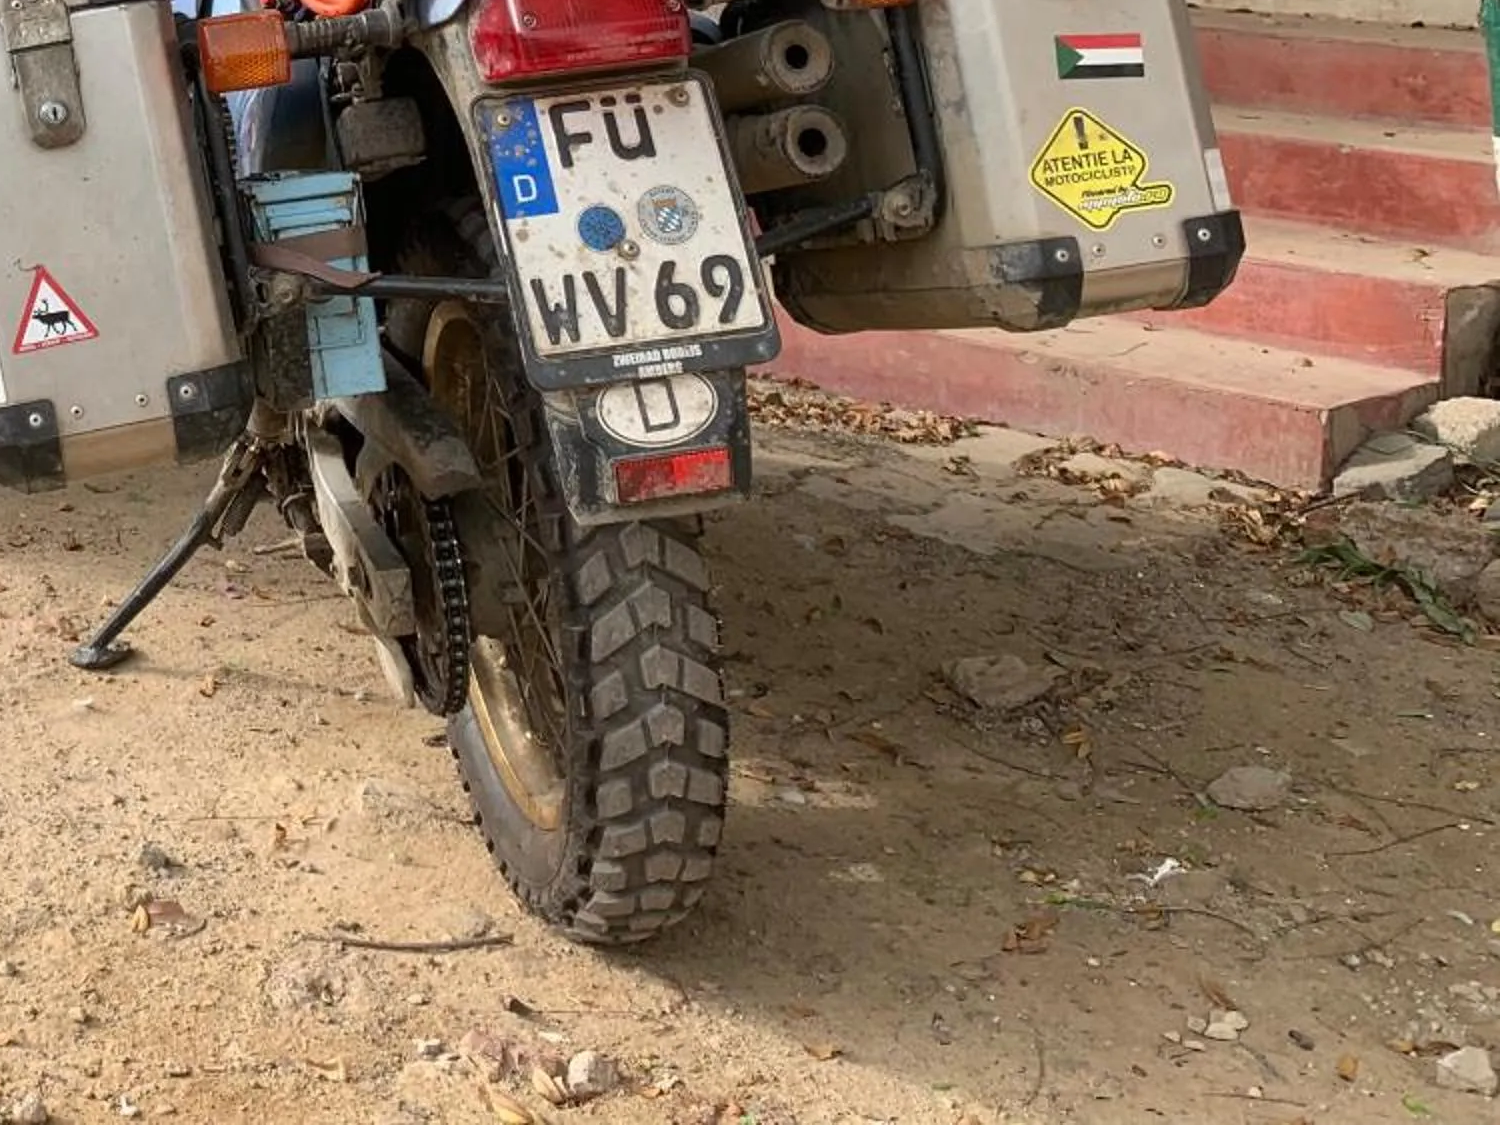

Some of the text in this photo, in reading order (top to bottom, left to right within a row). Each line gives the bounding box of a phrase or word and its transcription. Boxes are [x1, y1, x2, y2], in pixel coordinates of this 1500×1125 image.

[548, 92, 657, 169] FÜ
[513, 174, 538, 203] D
[1043, 148, 1133, 174] ATENTIE LA
[530, 254, 745, 346] WV 69
[633, 377, 681, 434] D
